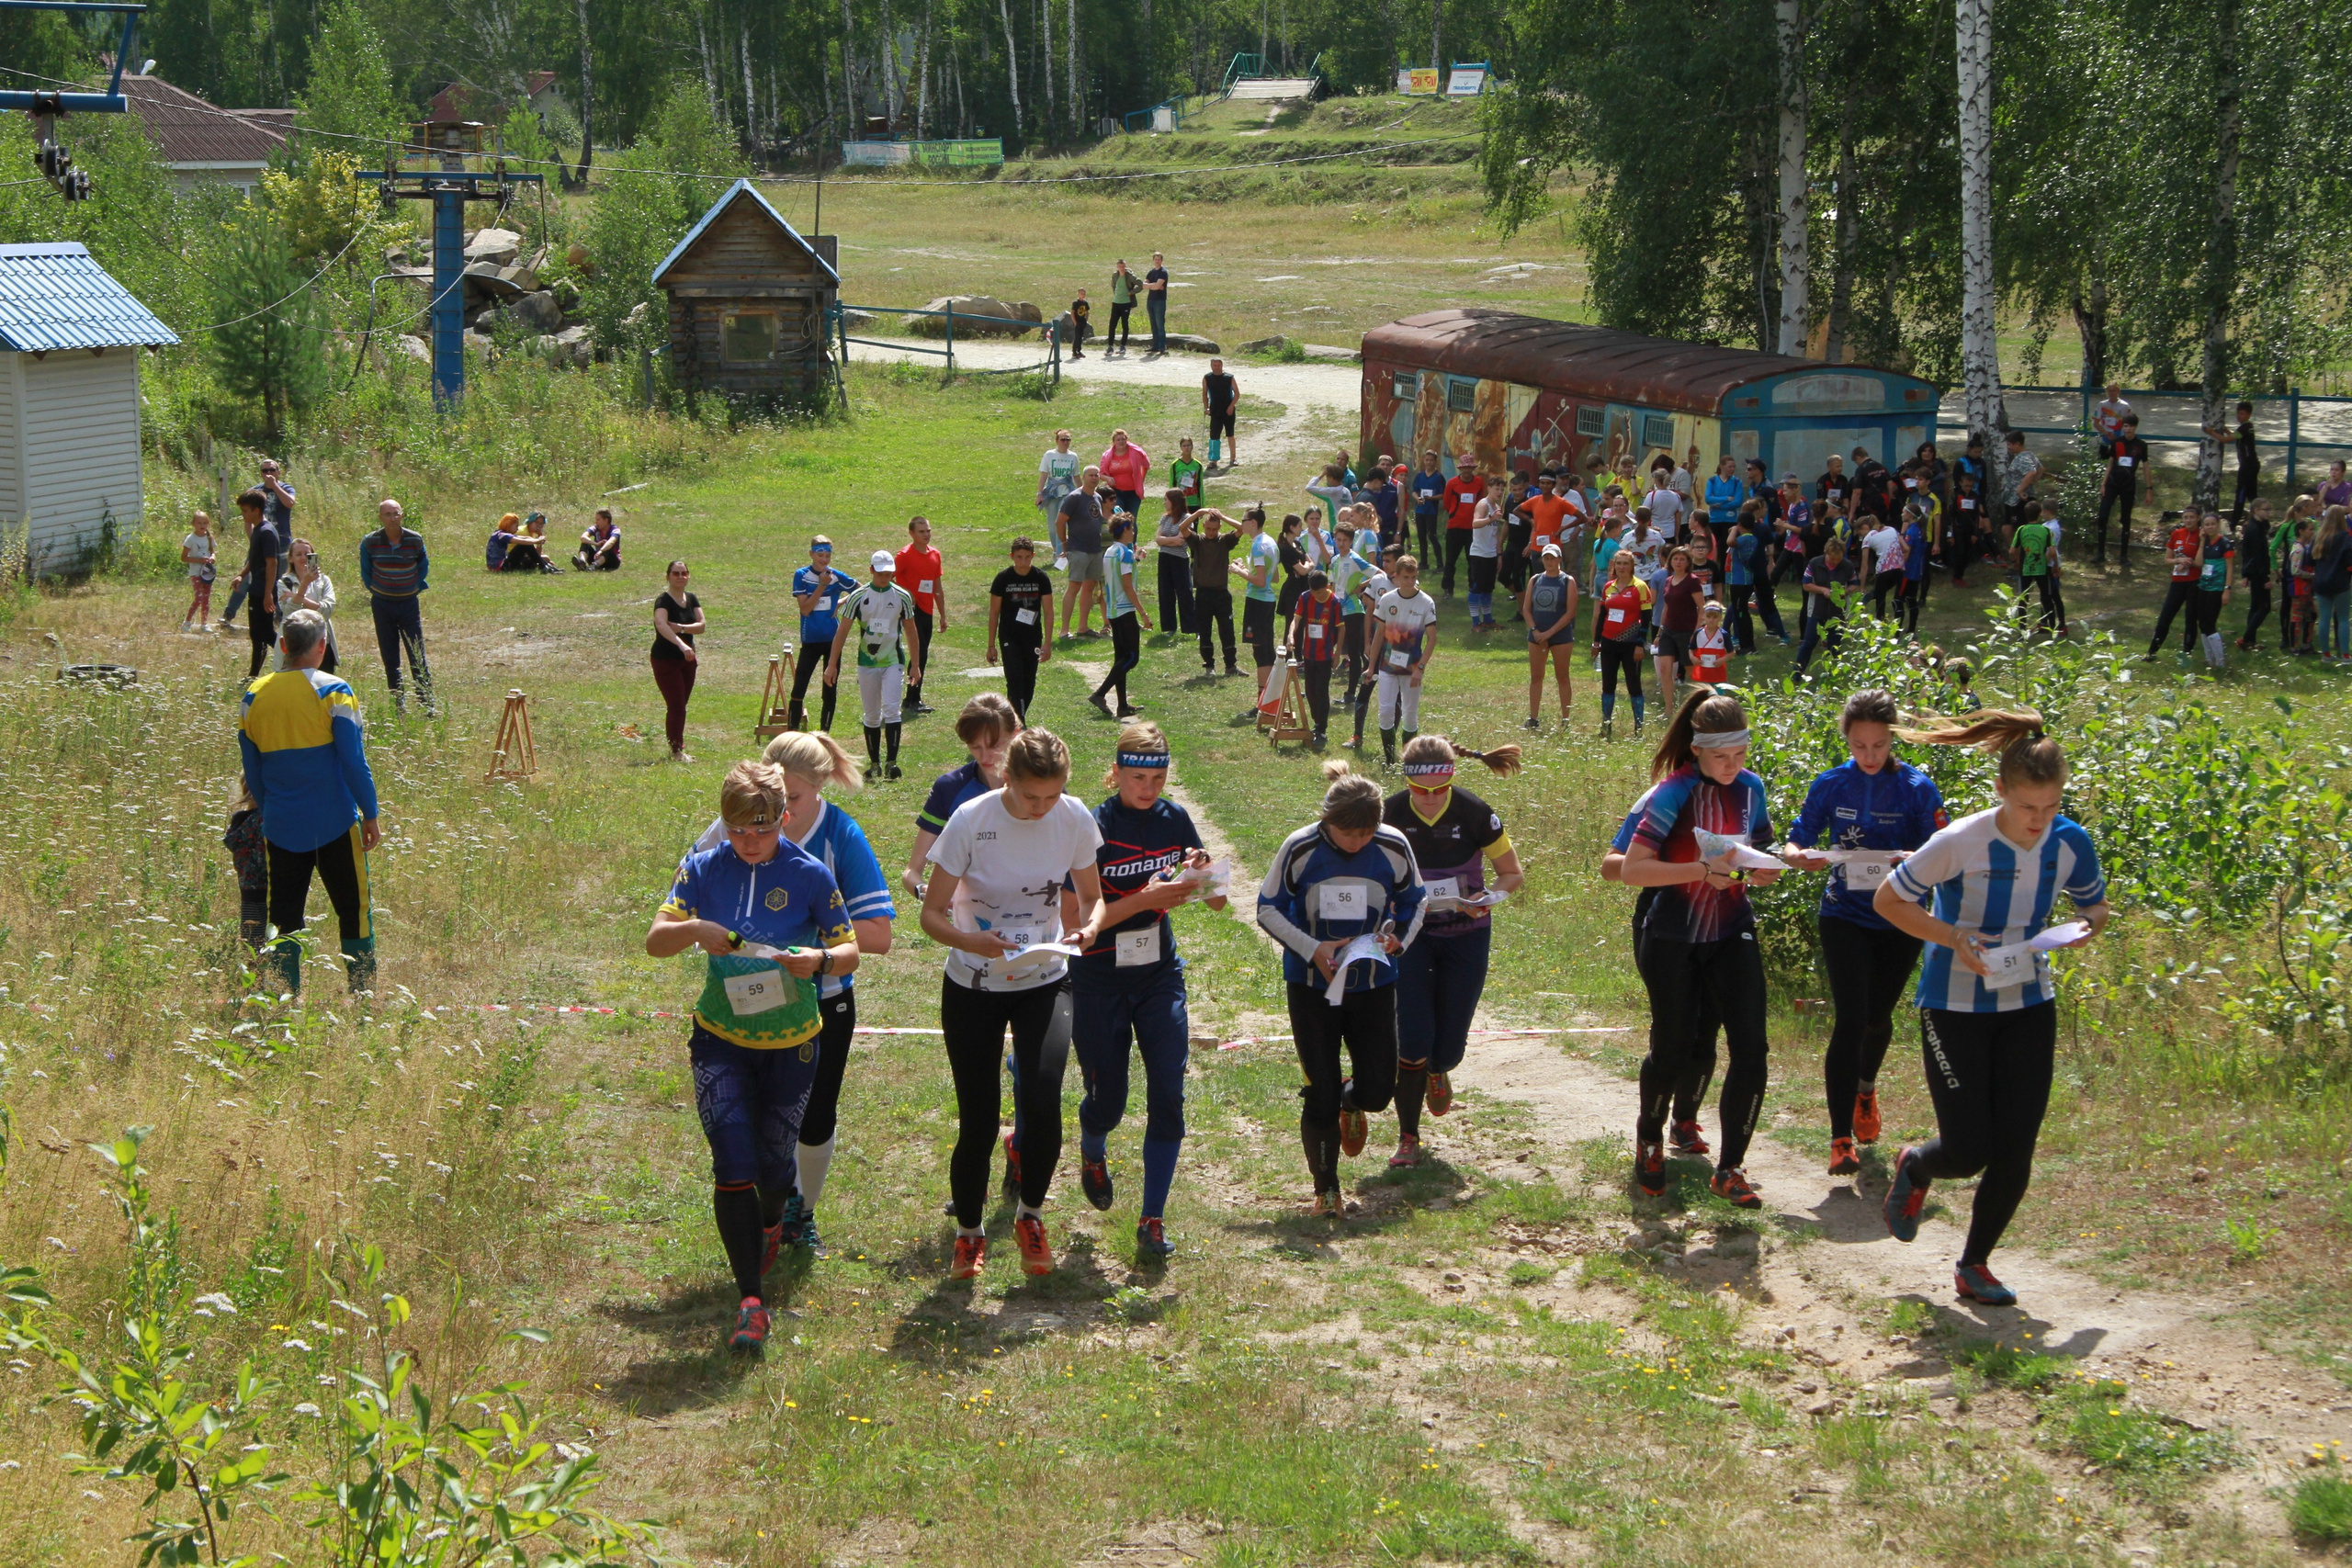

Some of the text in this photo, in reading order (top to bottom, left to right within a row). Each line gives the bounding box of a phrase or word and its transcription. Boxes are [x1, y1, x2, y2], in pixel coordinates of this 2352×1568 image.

[1405, 763, 1453, 774] TRIMTEX
[977, 831, 997, 840] 2021
[1102, 851, 1181, 876] noname
[1867, 865, 1880, 874] 60
[1339, 892, 1351, 902] 56
[1433, 887, 1446, 897] 62
[1014, 934, 1029, 944] 58
[1136, 937, 1148, 948] 57
[2004, 956, 2017, 967] 51
[749, 983, 763, 995] 59
[1922, 1009, 1960, 1089] bagheera
[1747, 1093, 1758, 1123] NORD
